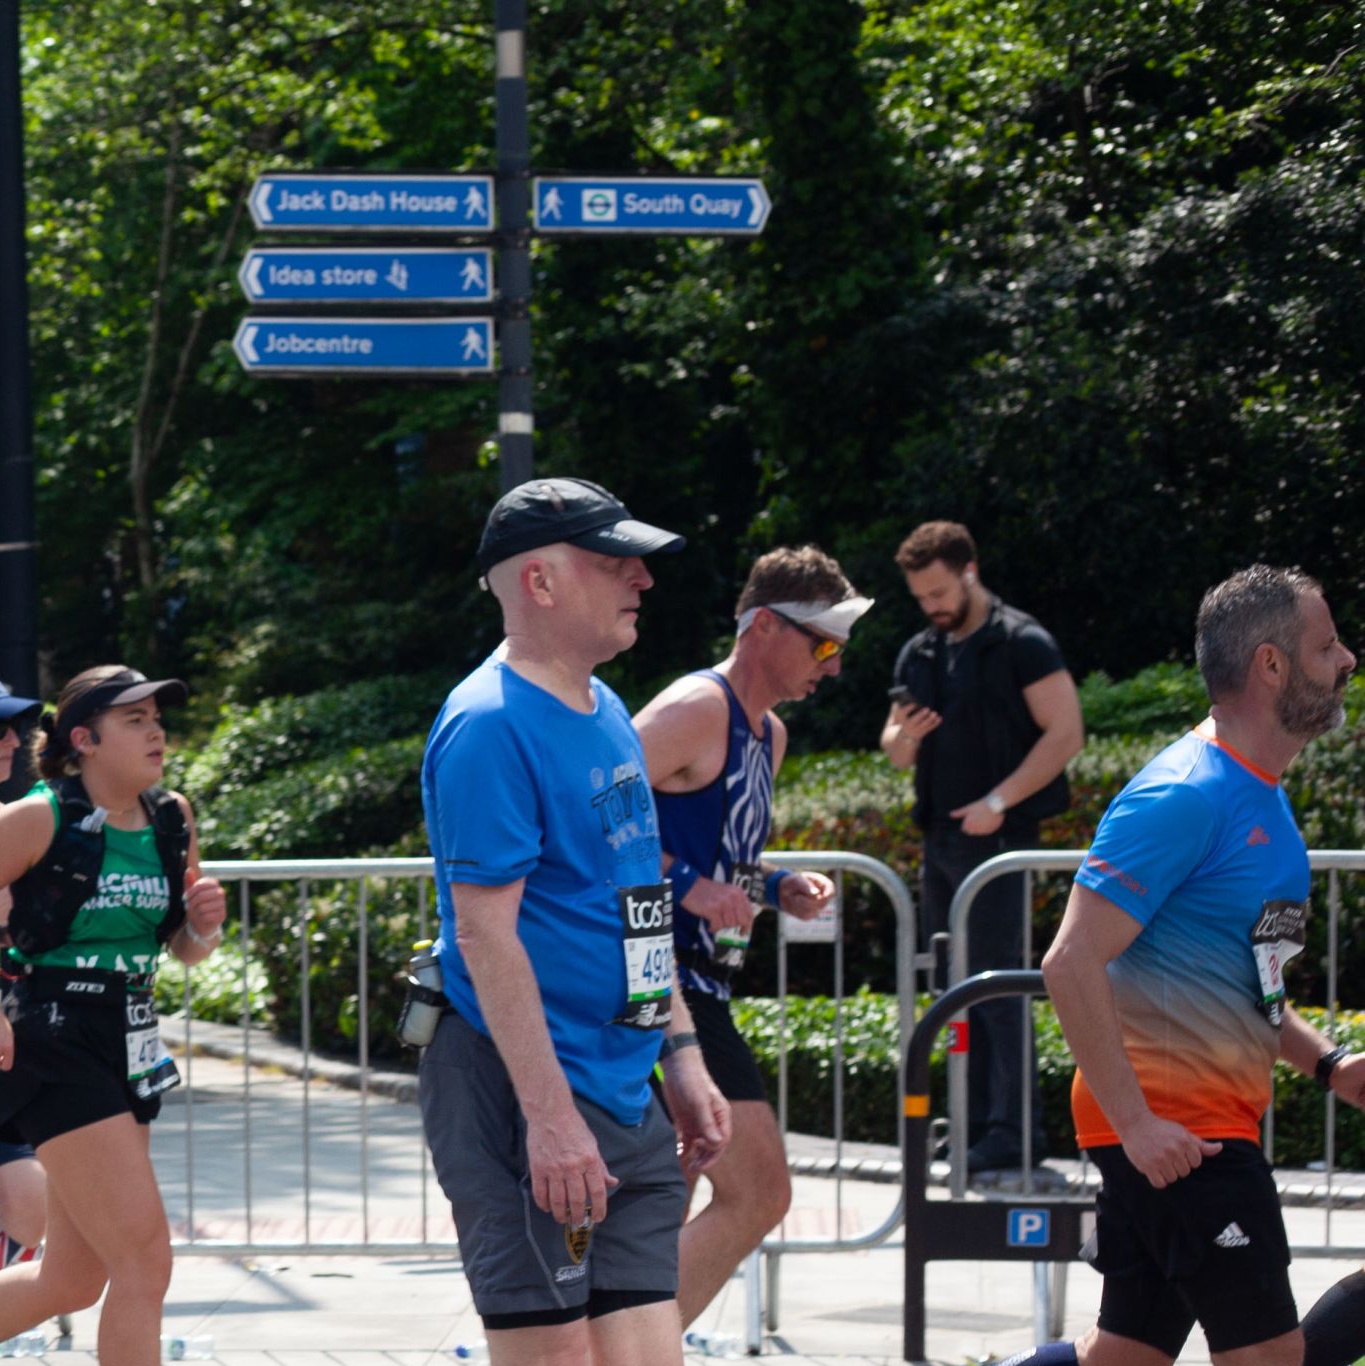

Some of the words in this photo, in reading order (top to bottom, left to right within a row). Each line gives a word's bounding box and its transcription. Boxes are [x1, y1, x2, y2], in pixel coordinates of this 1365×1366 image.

[277, 190, 326, 211] Jack
[331, 190, 385, 211] Dash
[390, 191, 458, 212] House
[623, 192, 684, 214] South
[689, 193, 742, 218] Quay
[270, 264, 316, 285] Idea
[321, 265, 377, 286] store
[264, 333, 373, 354] Jobcentre
[626, 895, 663, 930] tcs
[1019, 1213, 1043, 1243] P
